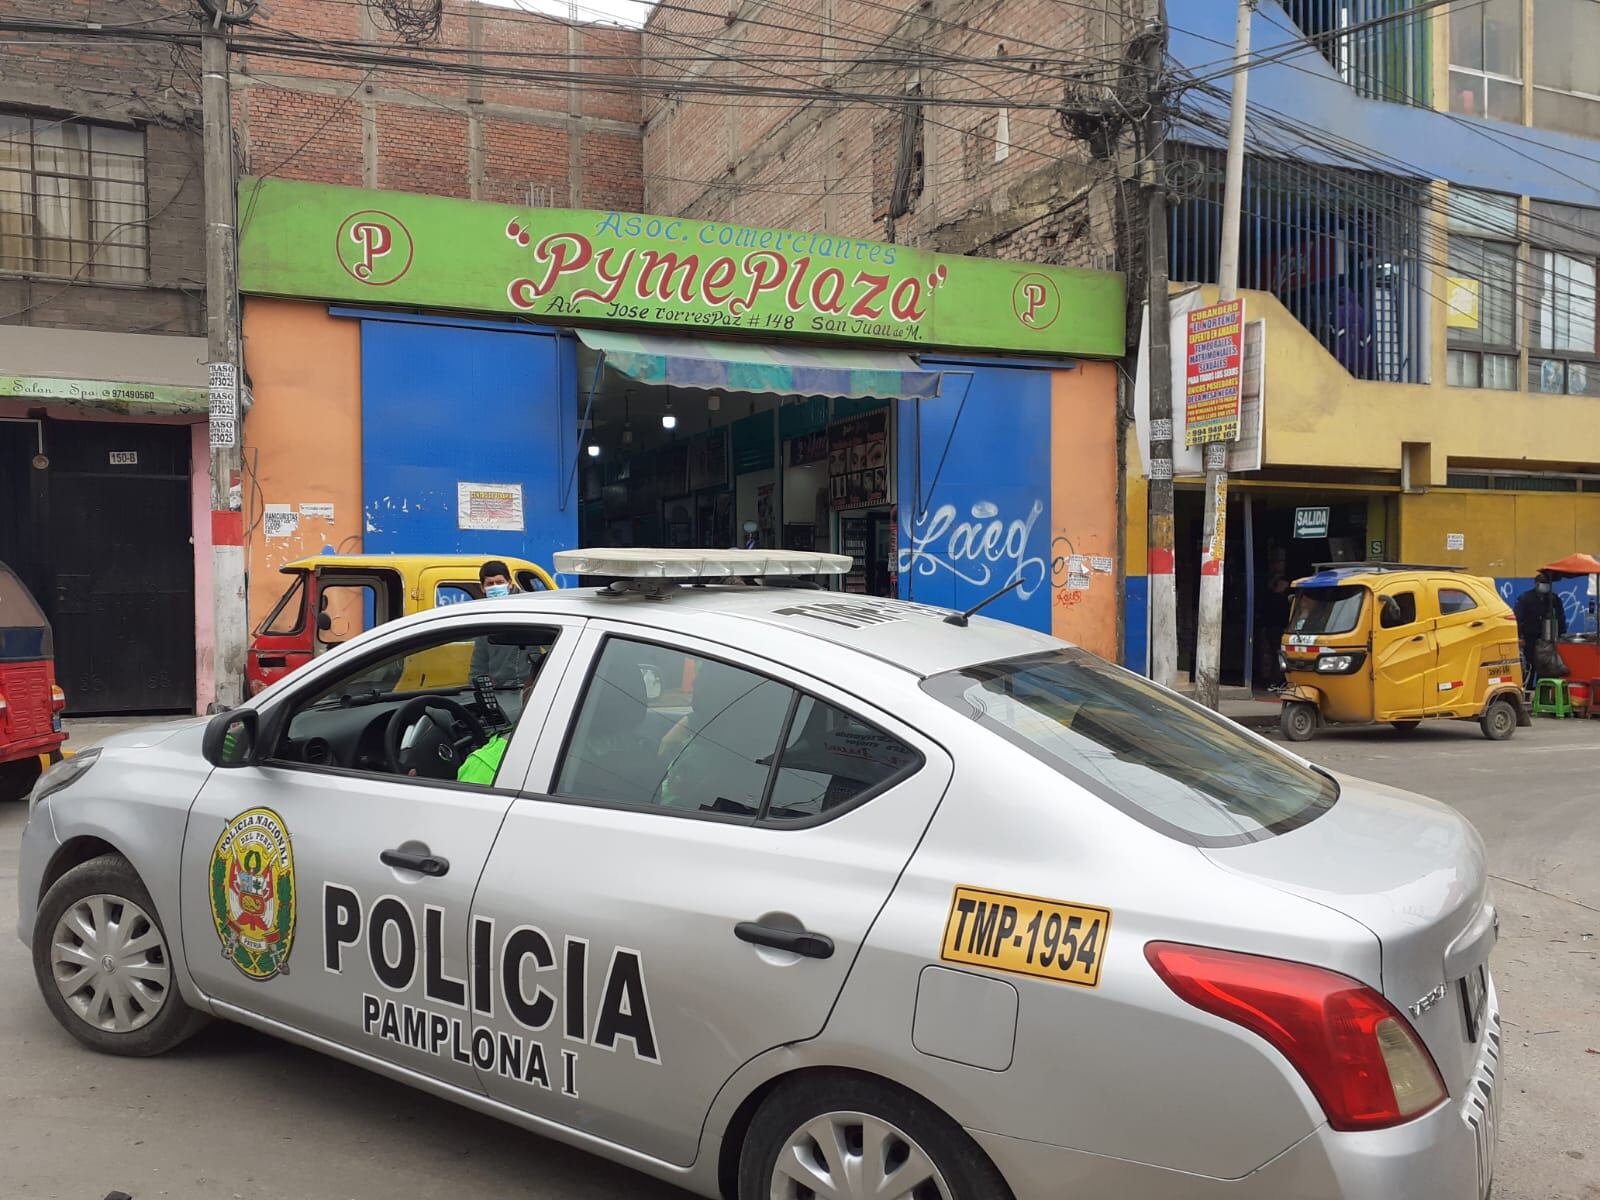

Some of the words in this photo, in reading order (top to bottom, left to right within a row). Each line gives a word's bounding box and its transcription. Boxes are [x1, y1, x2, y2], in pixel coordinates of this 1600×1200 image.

[596, 211, 688, 241] Asoc.
[350, 221, 392, 280] P
[544, 296, 581, 314] Av.
[606, 302, 650, 319] Jose
[766, 313, 795, 330] 148
[811, 316, 846, 333] San
[851, 320, 892, 336] Juan
[1022, 283, 1047, 322] P
[112, 391, 155, 399] 971490560
[1192, 428, 1206, 437] 994
[1208, 425, 1222, 434] 949
[1224, 422, 1237, 431] 144
[1297, 511, 1327, 526] SALIDA
[1372, 541, 1382, 554] S
[221, 816, 254, 851] POLICIA
[255, 816, 287, 864] NACIONAL
[954, 898, 1100, 974] TMP-1954
[323, 881, 661, 1065] POLICIA
[363, 993, 551, 1090] PAMPLONA
